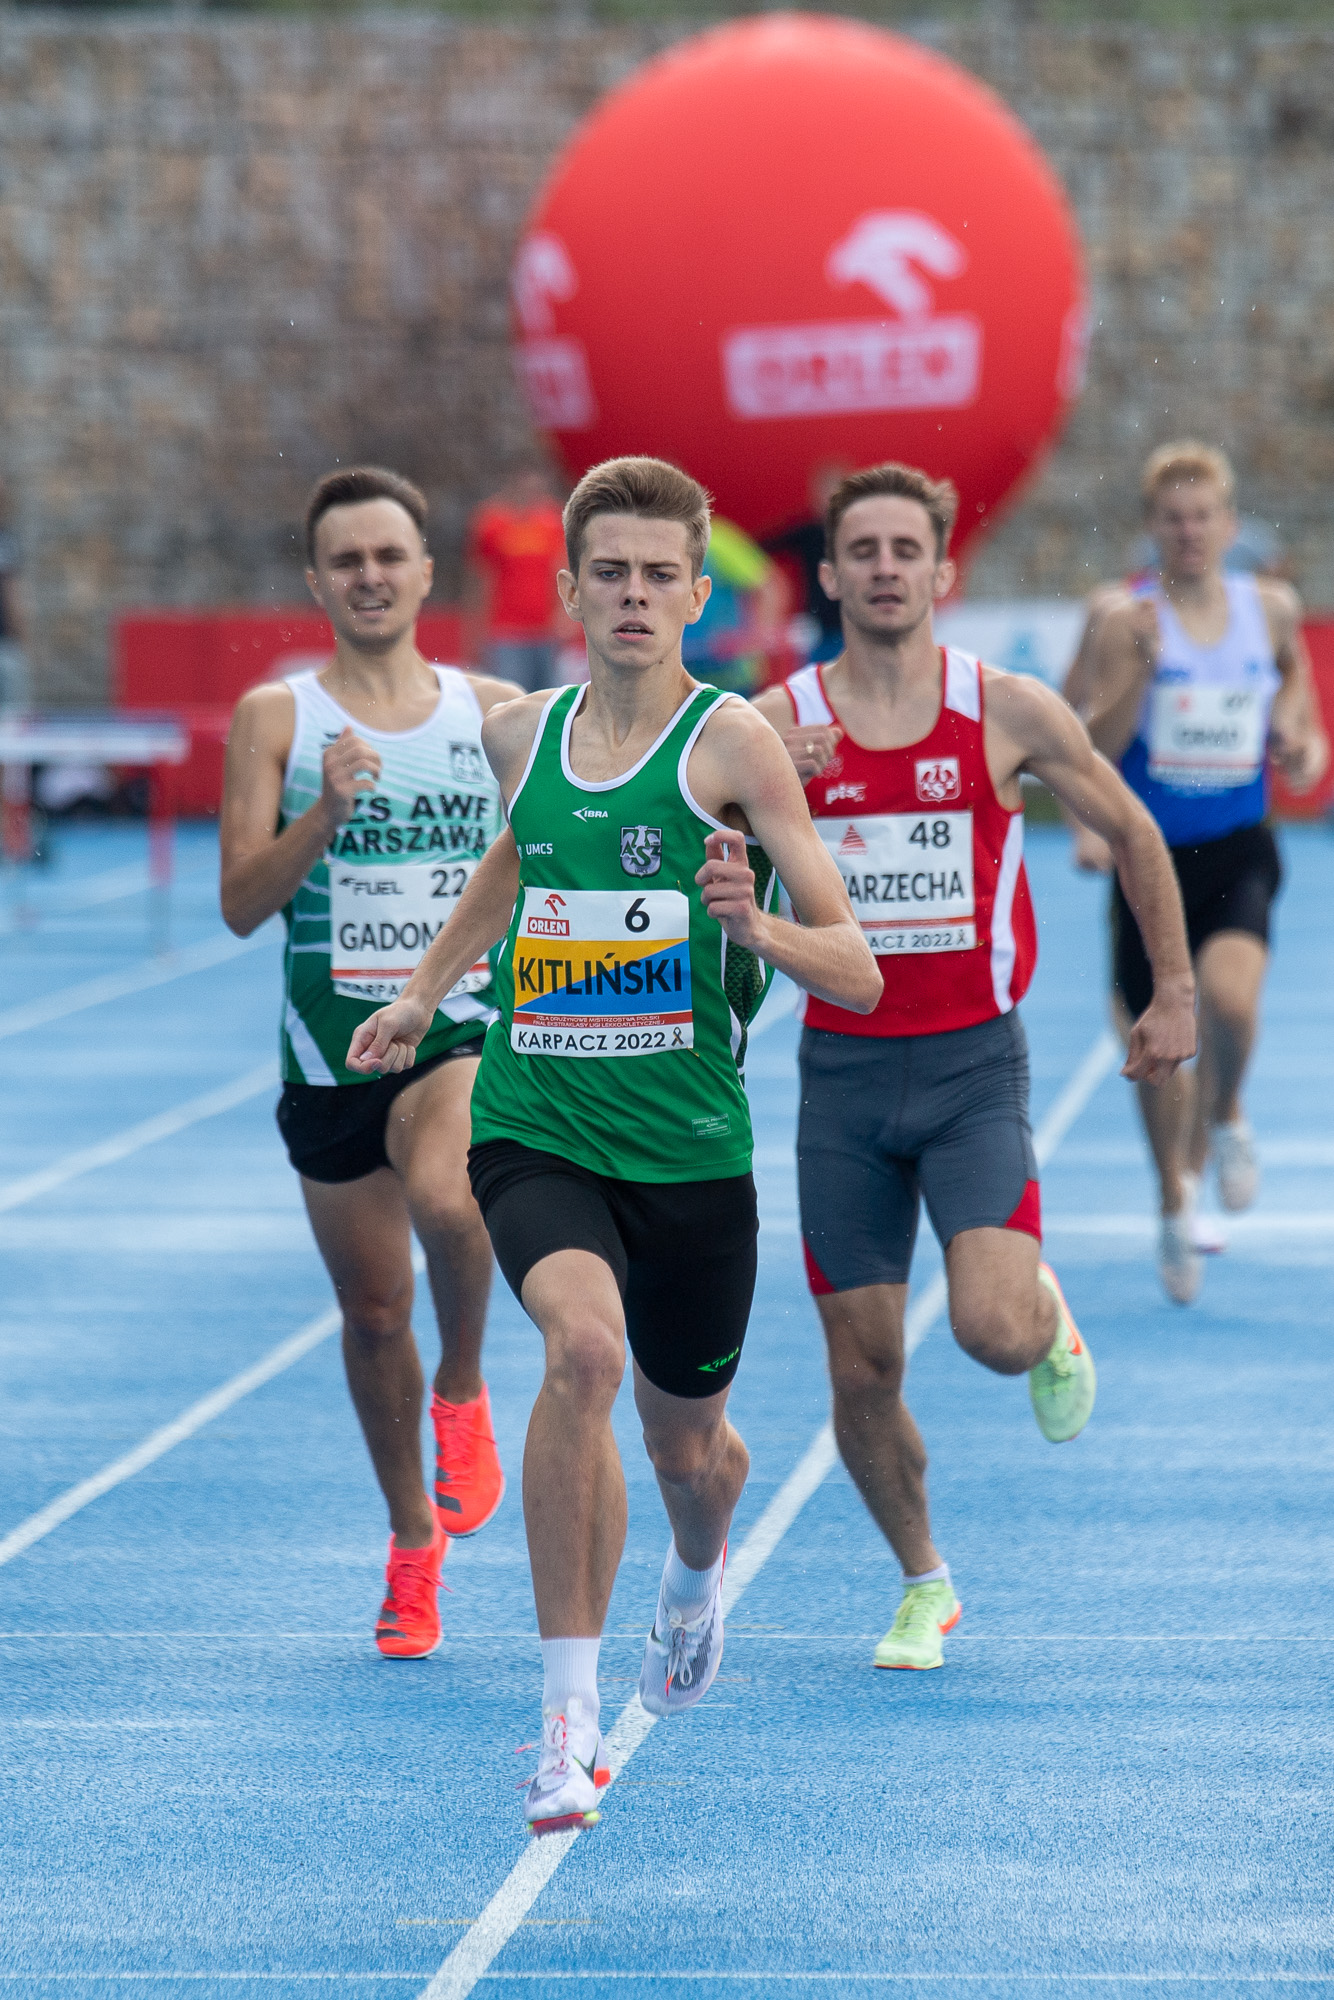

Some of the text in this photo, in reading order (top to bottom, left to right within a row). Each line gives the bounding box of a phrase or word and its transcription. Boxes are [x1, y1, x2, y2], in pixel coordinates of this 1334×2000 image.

[584, 809, 609, 819] IBRA
[908, 820, 952, 850] 48
[525, 842, 553, 856] UMCS
[843, 870, 965, 904] ARZECHA
[624, 897, 651, 934] 6
[529, 919, 567, 935] ORLEN
[911, 932, 953, 948] 2022
[518, 952, 683, 996] KITLIŃSKI
[517, 1031, 666, 1051] KARPACZ 2022
